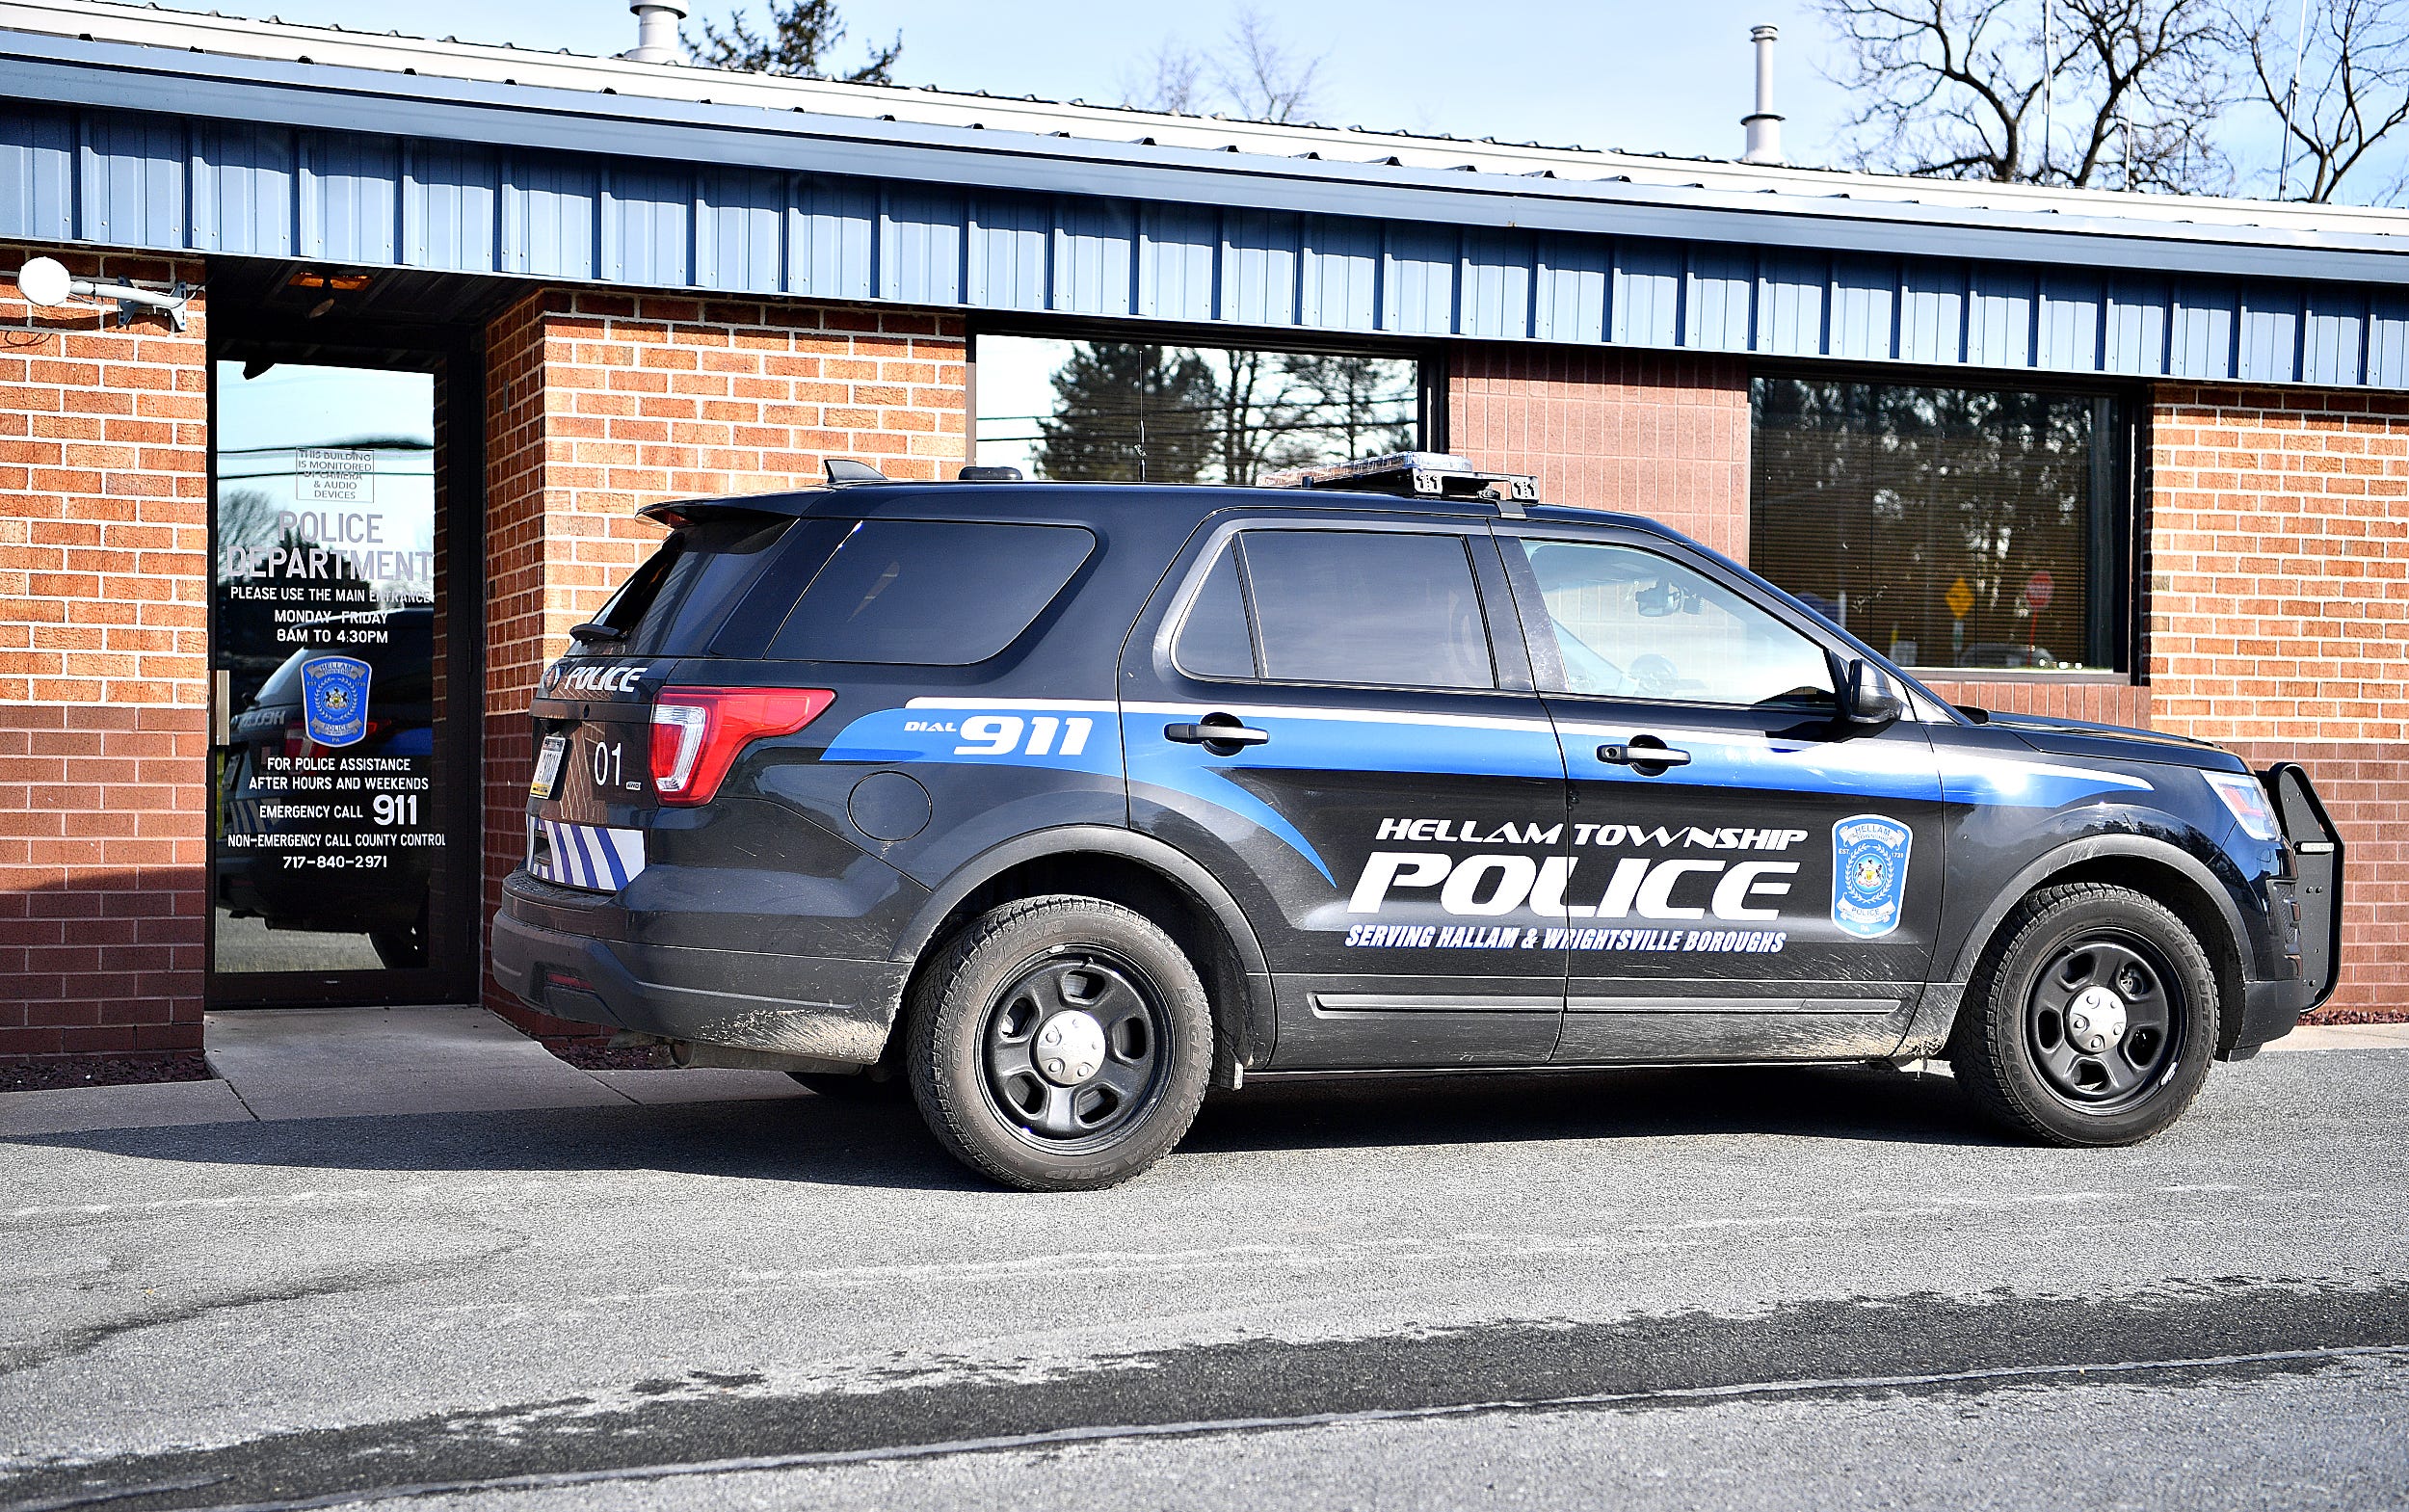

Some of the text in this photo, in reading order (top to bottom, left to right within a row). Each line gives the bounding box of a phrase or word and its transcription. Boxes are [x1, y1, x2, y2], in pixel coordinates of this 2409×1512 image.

[299, 449, 371, 462] THIS BUILDING
[309, 461, 372, 471] MONITORED
[319, 470, 362, 481] CAMERA
[324, 481, 357, 490] AUDIO
[314, 491, 356, 499] DEVICES
[278, 511, 384, 544] POLICE
[226, 545, 434, 581] DEPARTMENT
[230, 586, 430, 604] PLEASE USE THE MAIN ENTRANCE
[277, 628, 388, 644] 8AM TO 4:30PM
[565, 666, 649, 693] POLICE
[904, 715, 1094, 756] DIAL 911
[267, 757, 411, 771] FOR POLICE ASSISTANCE
[594, 741, 622, 786] 01
[249, 777, 429, 790] AFTER HOURS AND WEEKENDS
[259, 794, 417, 826] EMERGENCY CALL 911
[227, 834, 446, 848] NON-EMERGENCY CALL COUNTY CONTROL
[1375, 817, 1809, 851] HELLAM TOWNSHIP
[282, 856, 387, 868] 717-840-2971
[1346, 851, 1802, 921] POLICE
[1851, 907, 1881, 916] POLICE
[1345, 924, 1787, 954] SERVING HALLAM & WRIGHTSVILLE BOROUGHS
